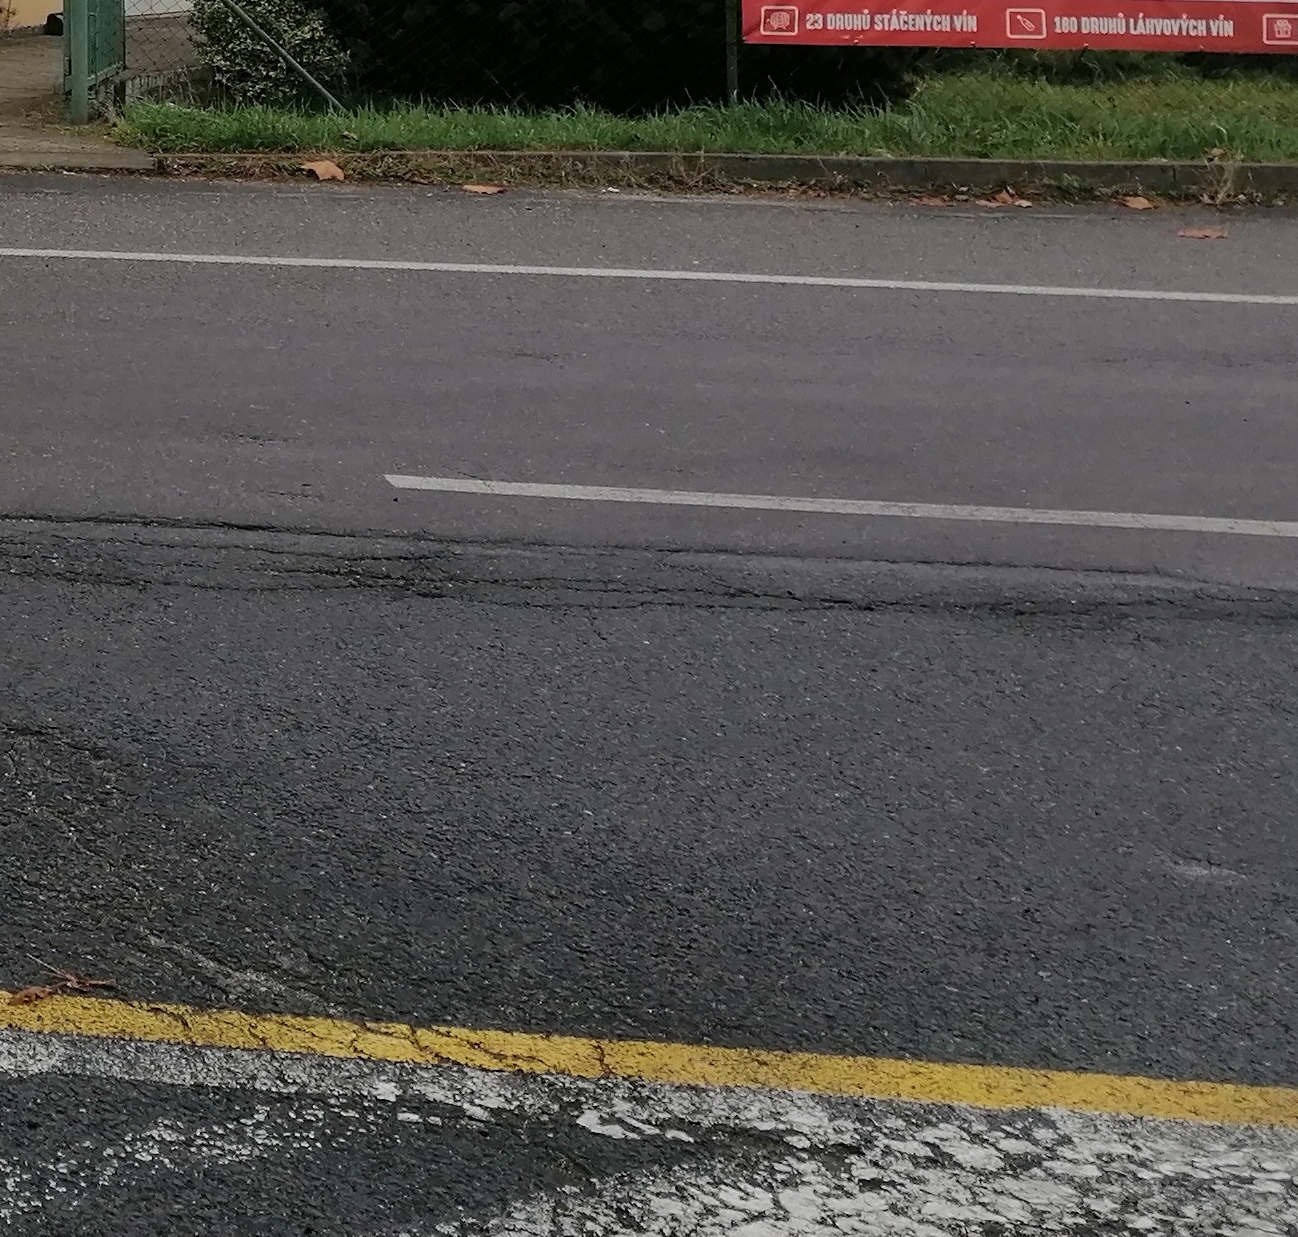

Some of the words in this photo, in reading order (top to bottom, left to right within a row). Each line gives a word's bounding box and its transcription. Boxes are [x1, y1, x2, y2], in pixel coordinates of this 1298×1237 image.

[805, 13, 823, 30] 23
[826, 8, 871, 31] DRUHŮ
[874, 8, 951, 33] STÁČENÝCH
[953, 9, 978, 33] VÍN
[1081, 12, 1127, 35] DRUHŮ
[1129, 12, 1207, 37] LÁHVOVÝCH
[1209, 14, 1234, 38] VÍN
